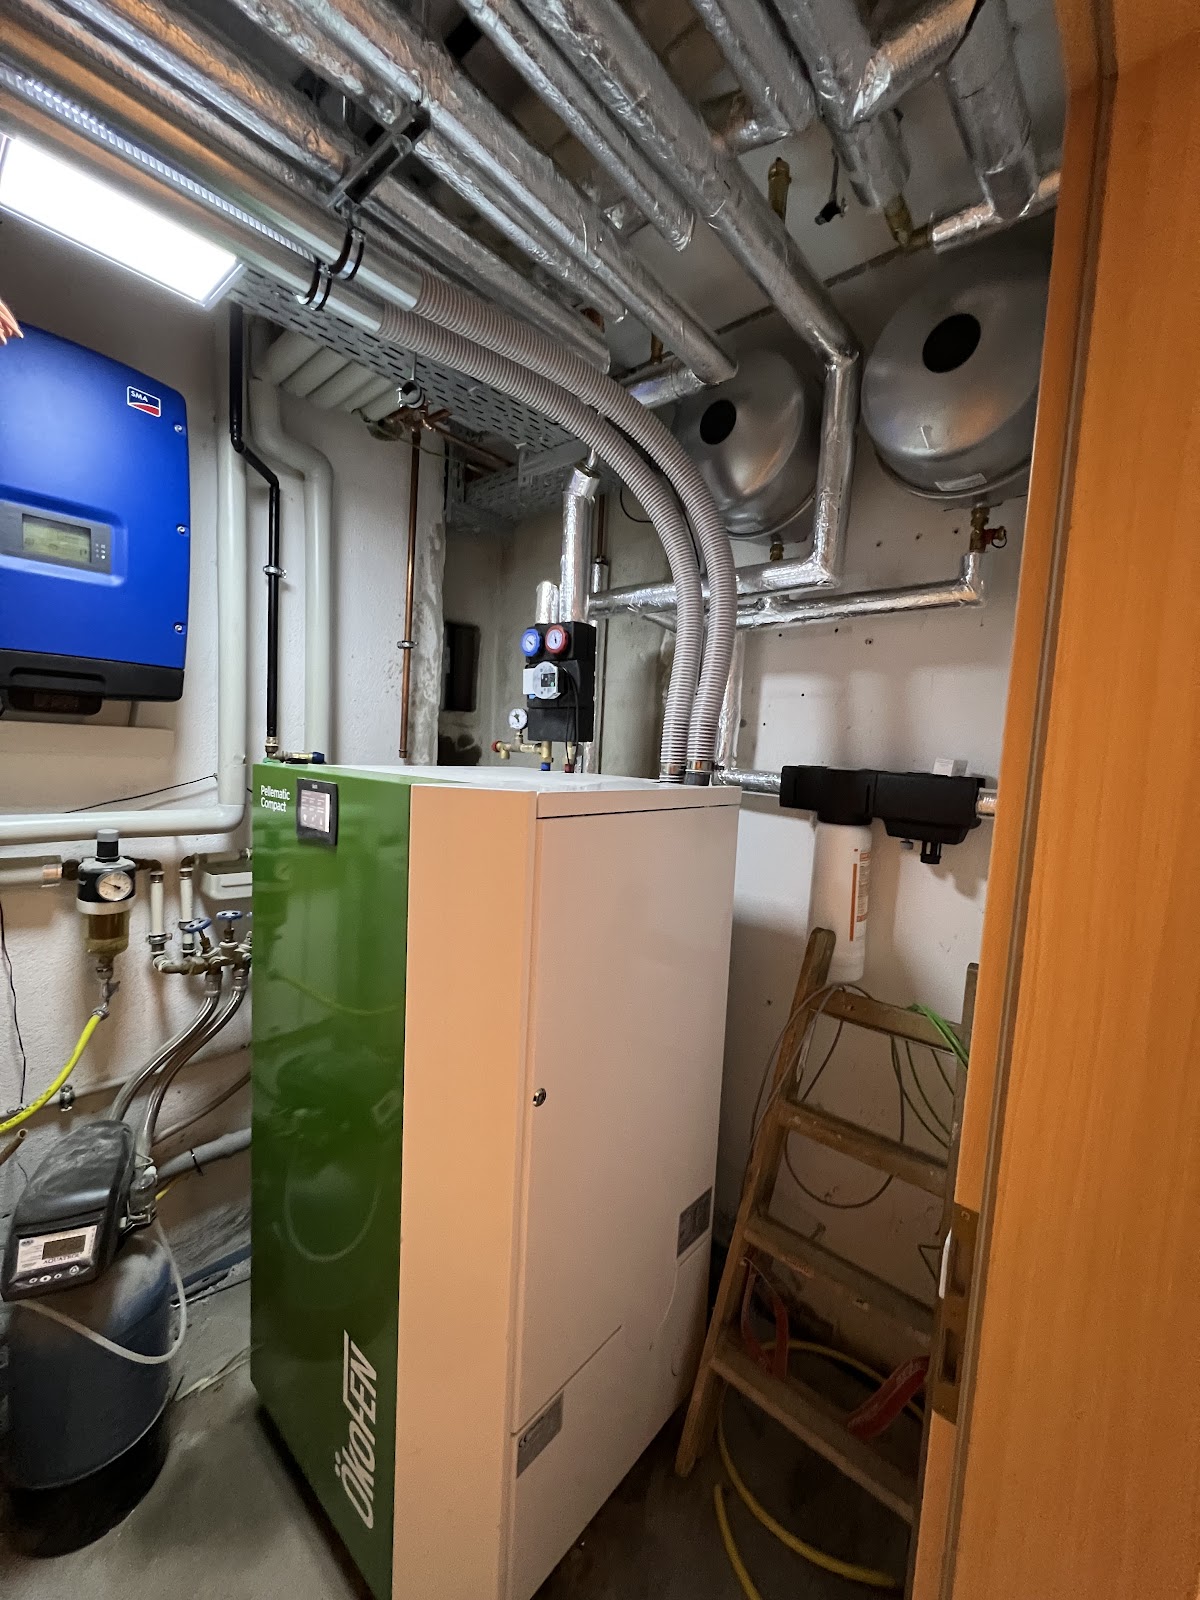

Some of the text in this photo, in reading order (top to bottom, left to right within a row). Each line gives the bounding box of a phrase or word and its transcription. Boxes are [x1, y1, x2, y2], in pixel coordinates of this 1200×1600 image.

[130, 390, 148, 402] SMA
[260, 785, 290, 800] Pellematic
[260, 797, 287, 812] Compact
